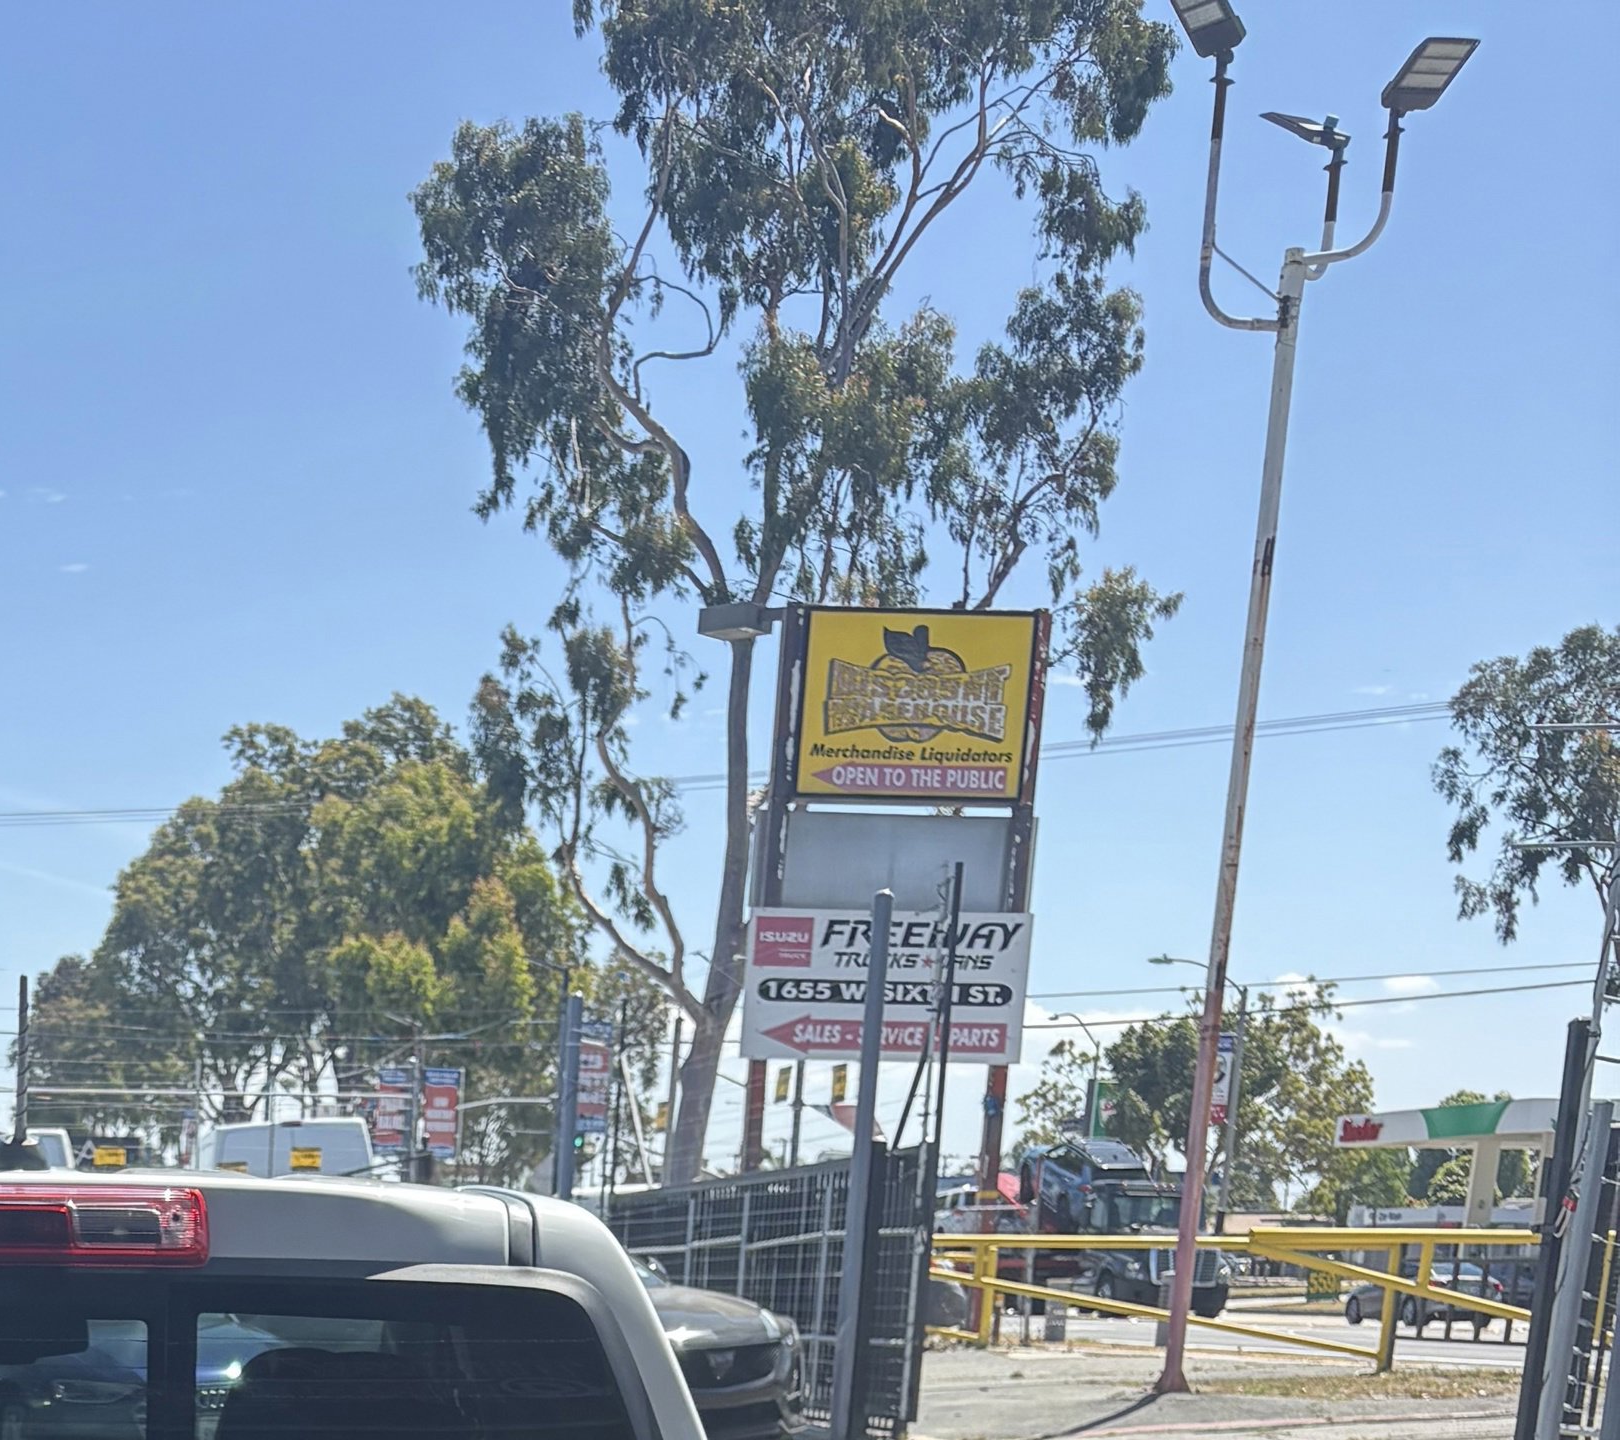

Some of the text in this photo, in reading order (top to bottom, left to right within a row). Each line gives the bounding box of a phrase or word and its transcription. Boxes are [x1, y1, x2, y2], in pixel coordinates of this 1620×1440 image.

[810, 743, 1014, 765] Merchandise Liquidators
[832, 766, 1005, 790] OPEN TO THE PUBLIC
[759, 930, 810, 943] ISUZU
[766, 981, 831, 1000] 1655
[966, 985, 1003, 1004] ST.
[793, 1024, 842, 1044] SALES
[949, 1028, 1000, 1047] PARTS
